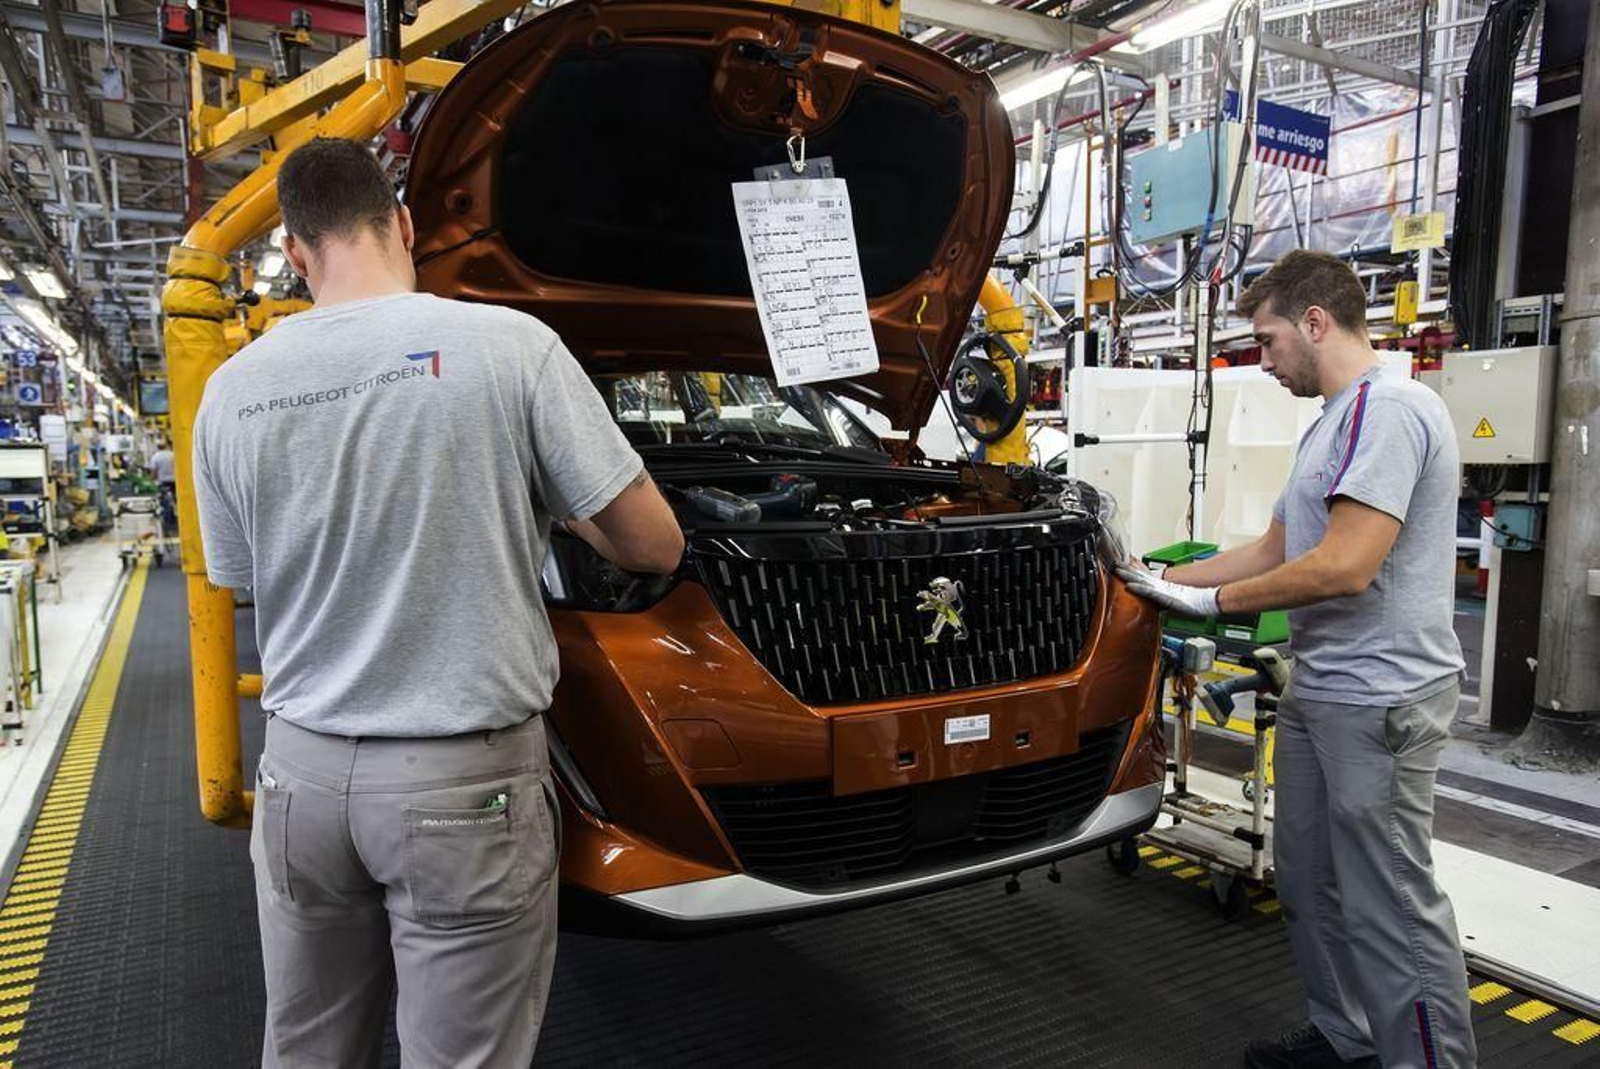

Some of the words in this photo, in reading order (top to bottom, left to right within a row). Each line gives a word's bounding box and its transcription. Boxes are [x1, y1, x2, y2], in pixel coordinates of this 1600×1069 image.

[1257, 123, 1276, 140] me
[1277, 128, 1325, 154] arriesgo
[17, 351, 37, 368] 53
[238, 402, 265, 421] PSA
[269, 386, 350, 412] PEUGEOT
